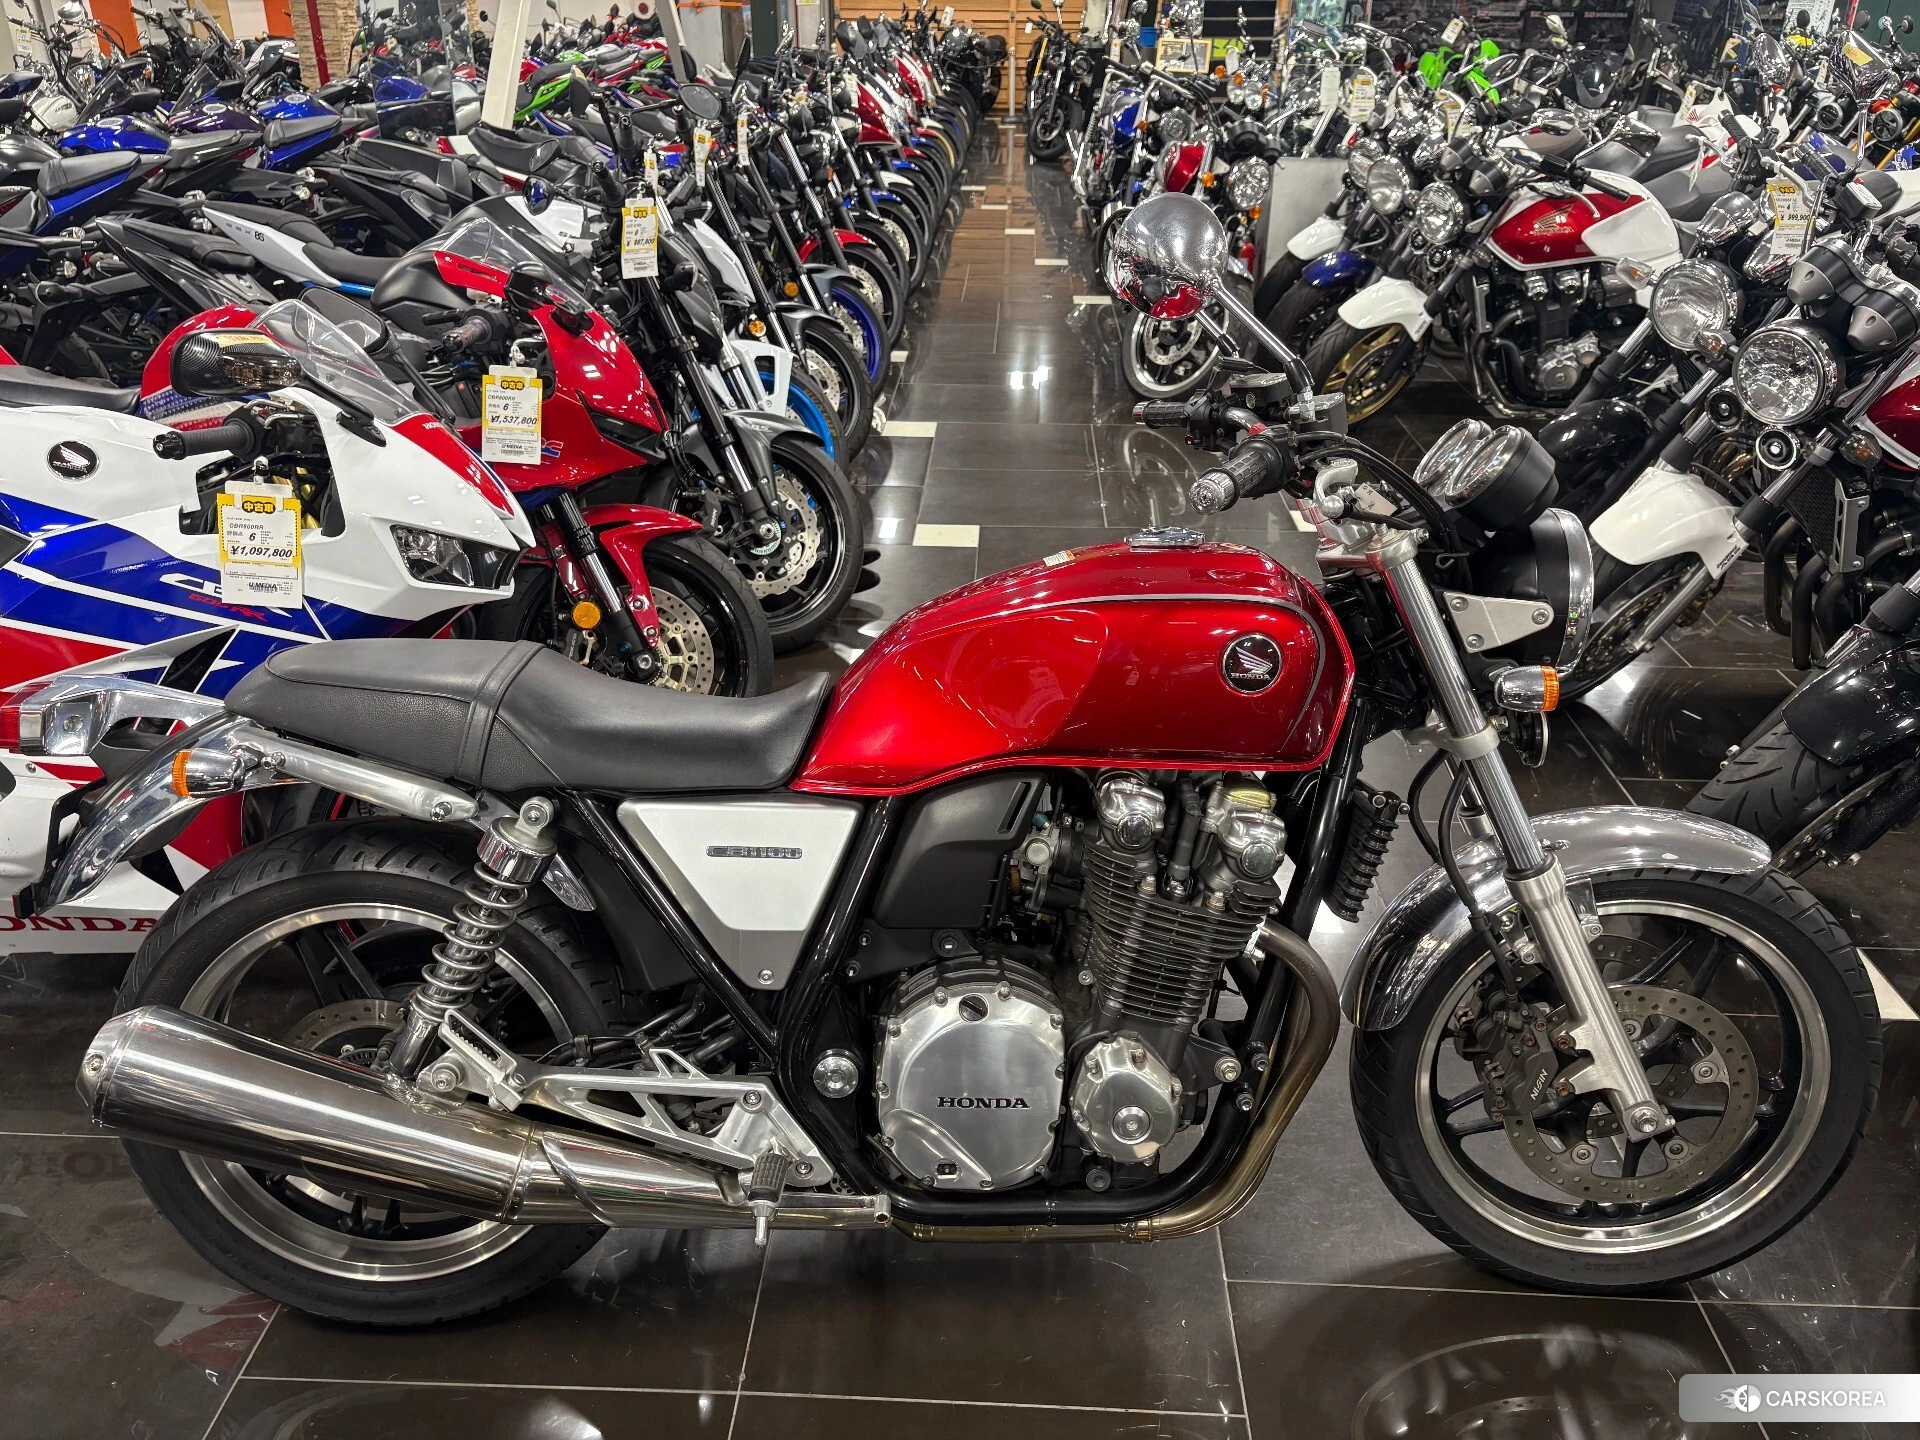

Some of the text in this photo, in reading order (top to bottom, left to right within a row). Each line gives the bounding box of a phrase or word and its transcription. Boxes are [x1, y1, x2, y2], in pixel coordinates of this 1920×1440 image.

[503, 403, 510, 411] 6
[243, 501, 276, 514] 中古車
[249, 532, 257, 542] 6
[230, 545, 293, 559] ¥1,097,800
[1230, 672, 1272, 681] HONDA
[1530, 1068, 1549, 1101] NISSIN
[936, 1096, 1032, 1109] HONDA
